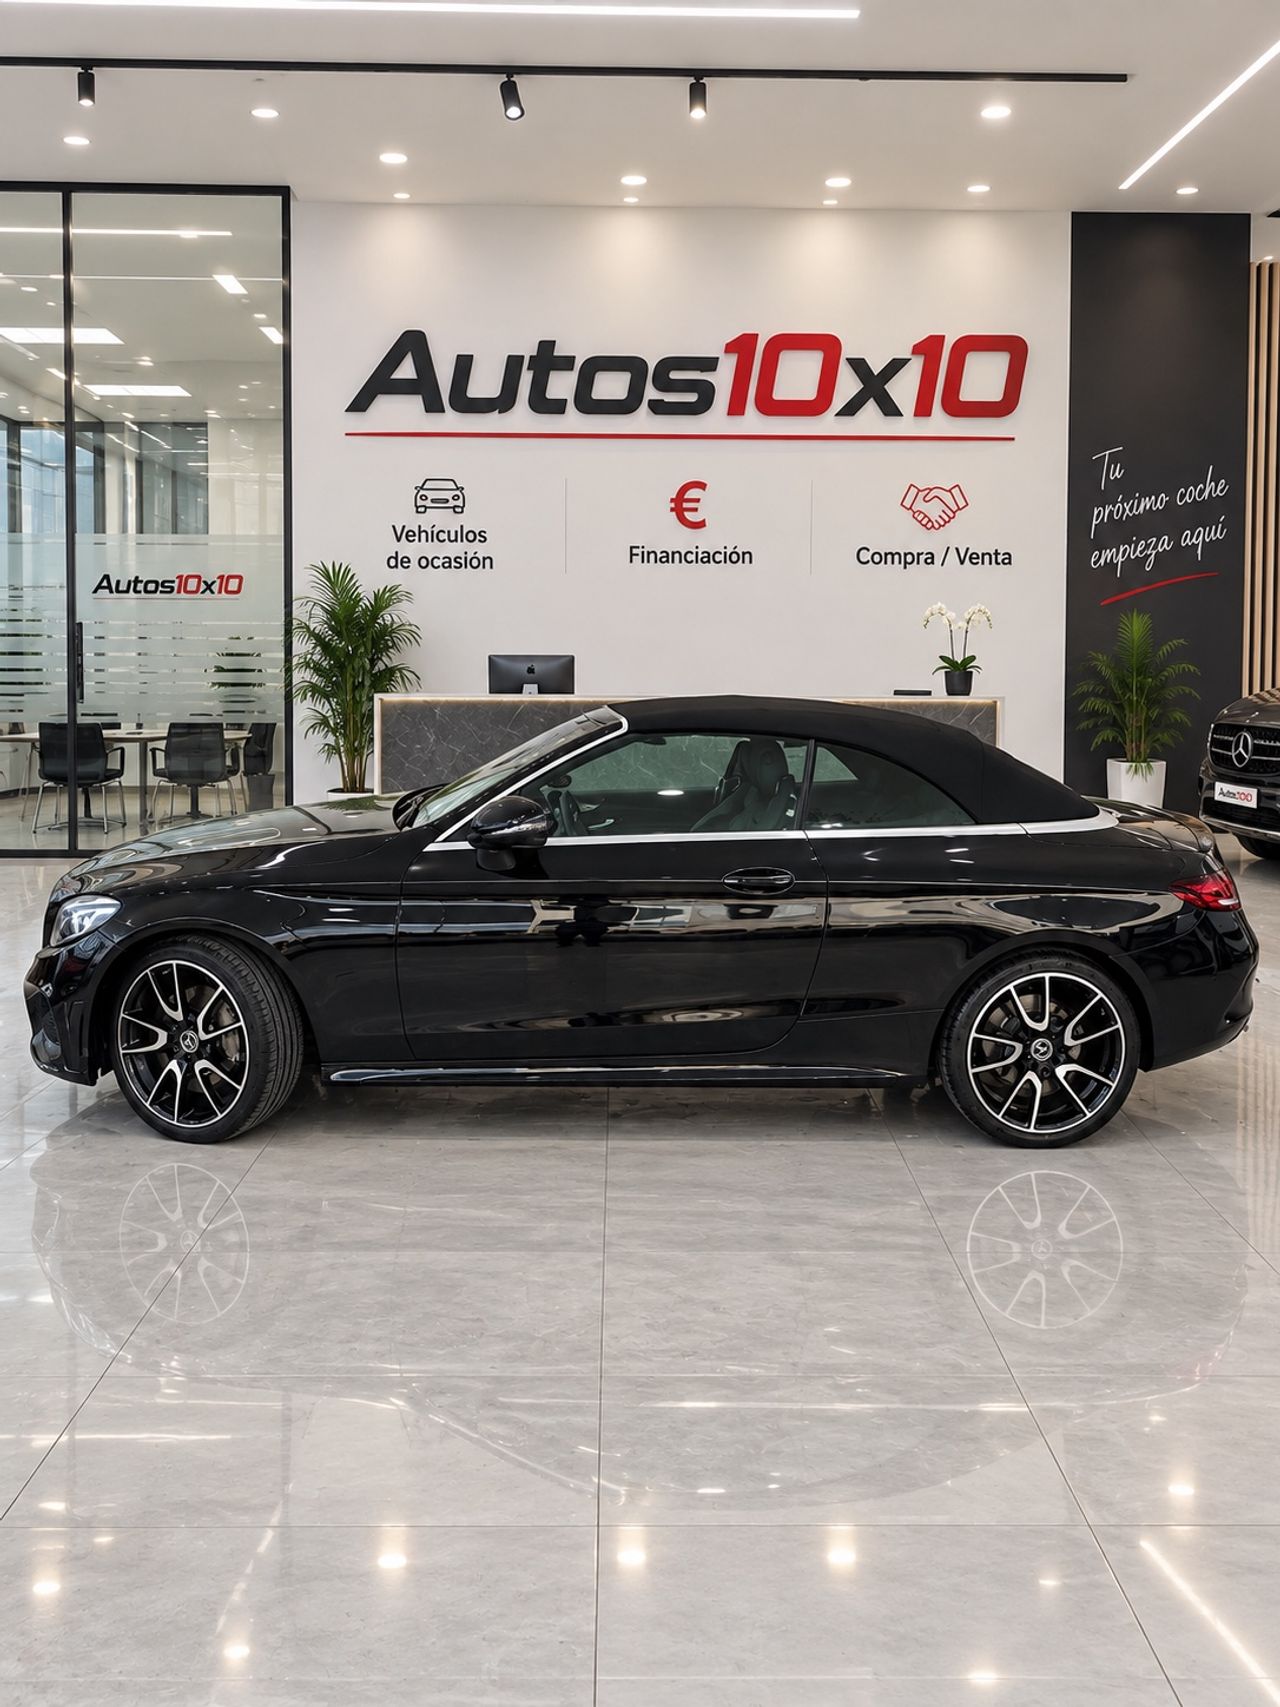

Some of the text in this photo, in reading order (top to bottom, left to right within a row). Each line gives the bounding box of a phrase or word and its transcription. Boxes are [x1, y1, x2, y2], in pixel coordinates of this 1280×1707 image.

[345, 330, 1028, 418] Autos10x10
[1092, 447, 1124, 490] Tu
[1091, 465, 1229, 539] próximo coche
[392, 524, 487, 543] Vehículos
[630, 546, 752, 565] Financiación
[1091, 516, 1227, 577] empieza aquí
[387, 551, 493, 569] de ocasión
[856, 547, 934, 570] Compra
[955, 547, 1012, 566] Venta
[92, 574, 244, 595] Autos10x10
